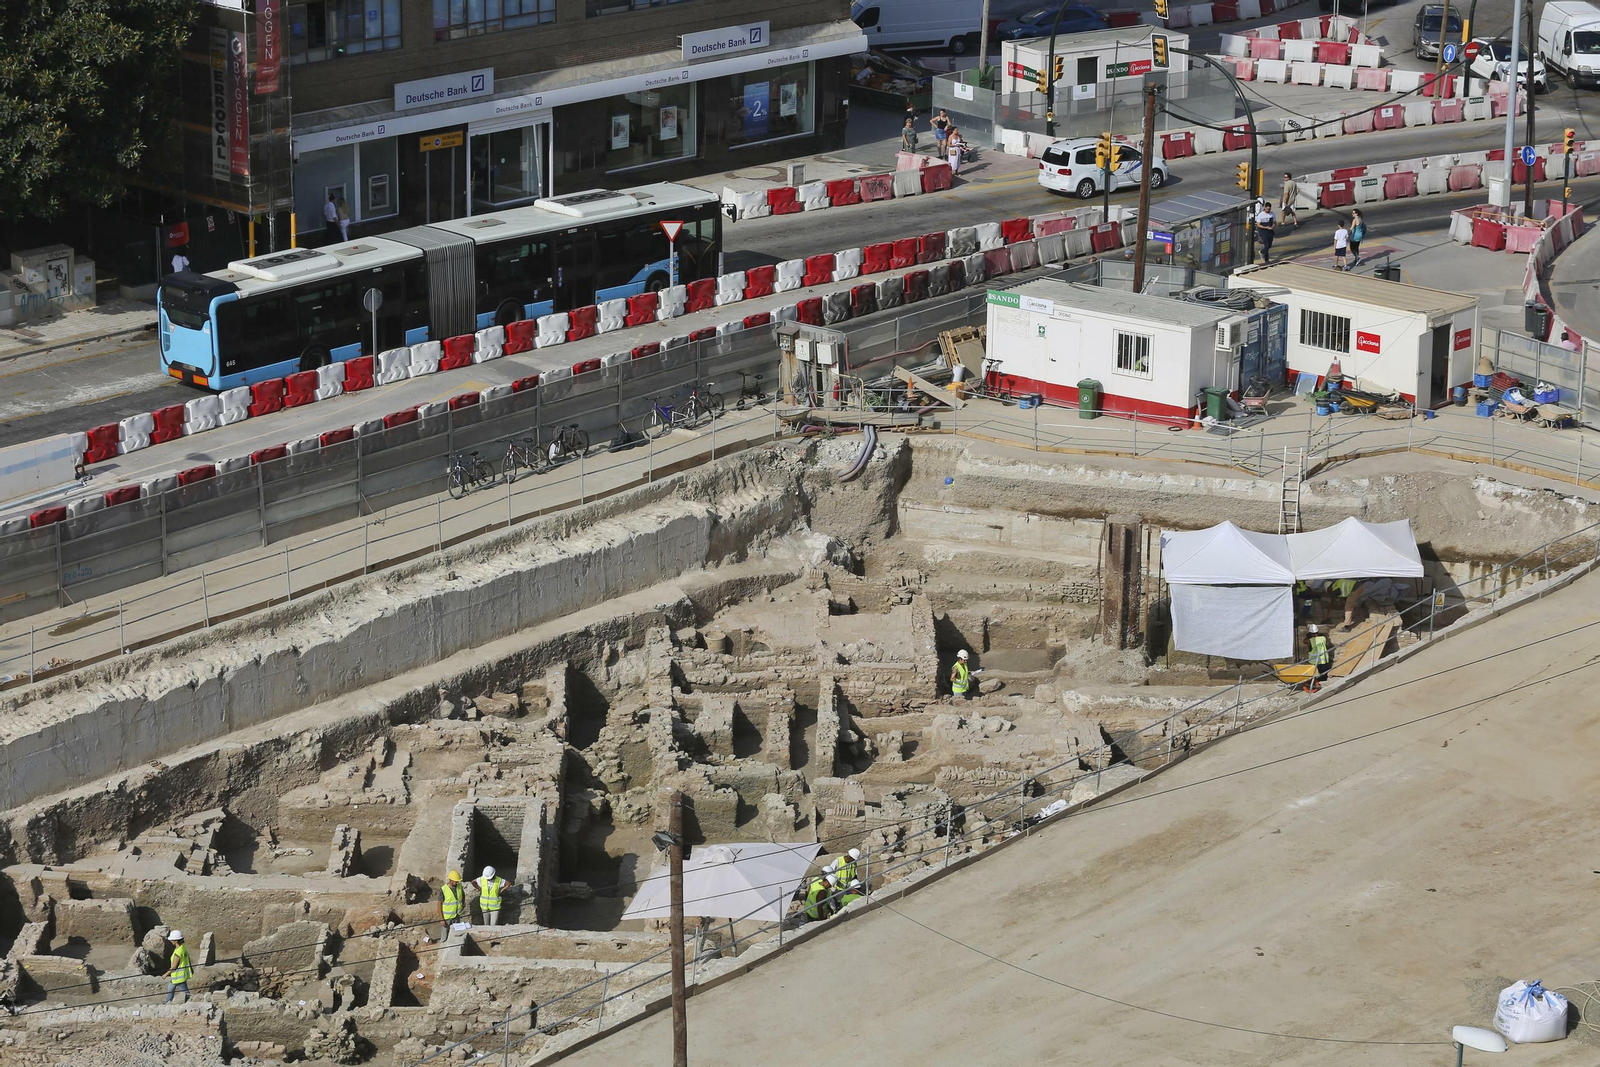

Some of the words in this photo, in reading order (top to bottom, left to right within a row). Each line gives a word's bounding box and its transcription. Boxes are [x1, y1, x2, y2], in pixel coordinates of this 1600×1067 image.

[692, 40, 726, 54] Deutsche
[728, 37, 747, 48] Bank
[767, 56, 789, 65] Deutsche
[645, 79, 667, 87] Deutsche
[405, 90, 445, 104] Deutsche
[447, 85, 469, 97] Bank
[496, 105, 520, 114] Deutsche
[336, 133, 361, 143] Deutsche
[361, 130, 376, 138] Bank
[992, 293, 1019, 304] SANDO
